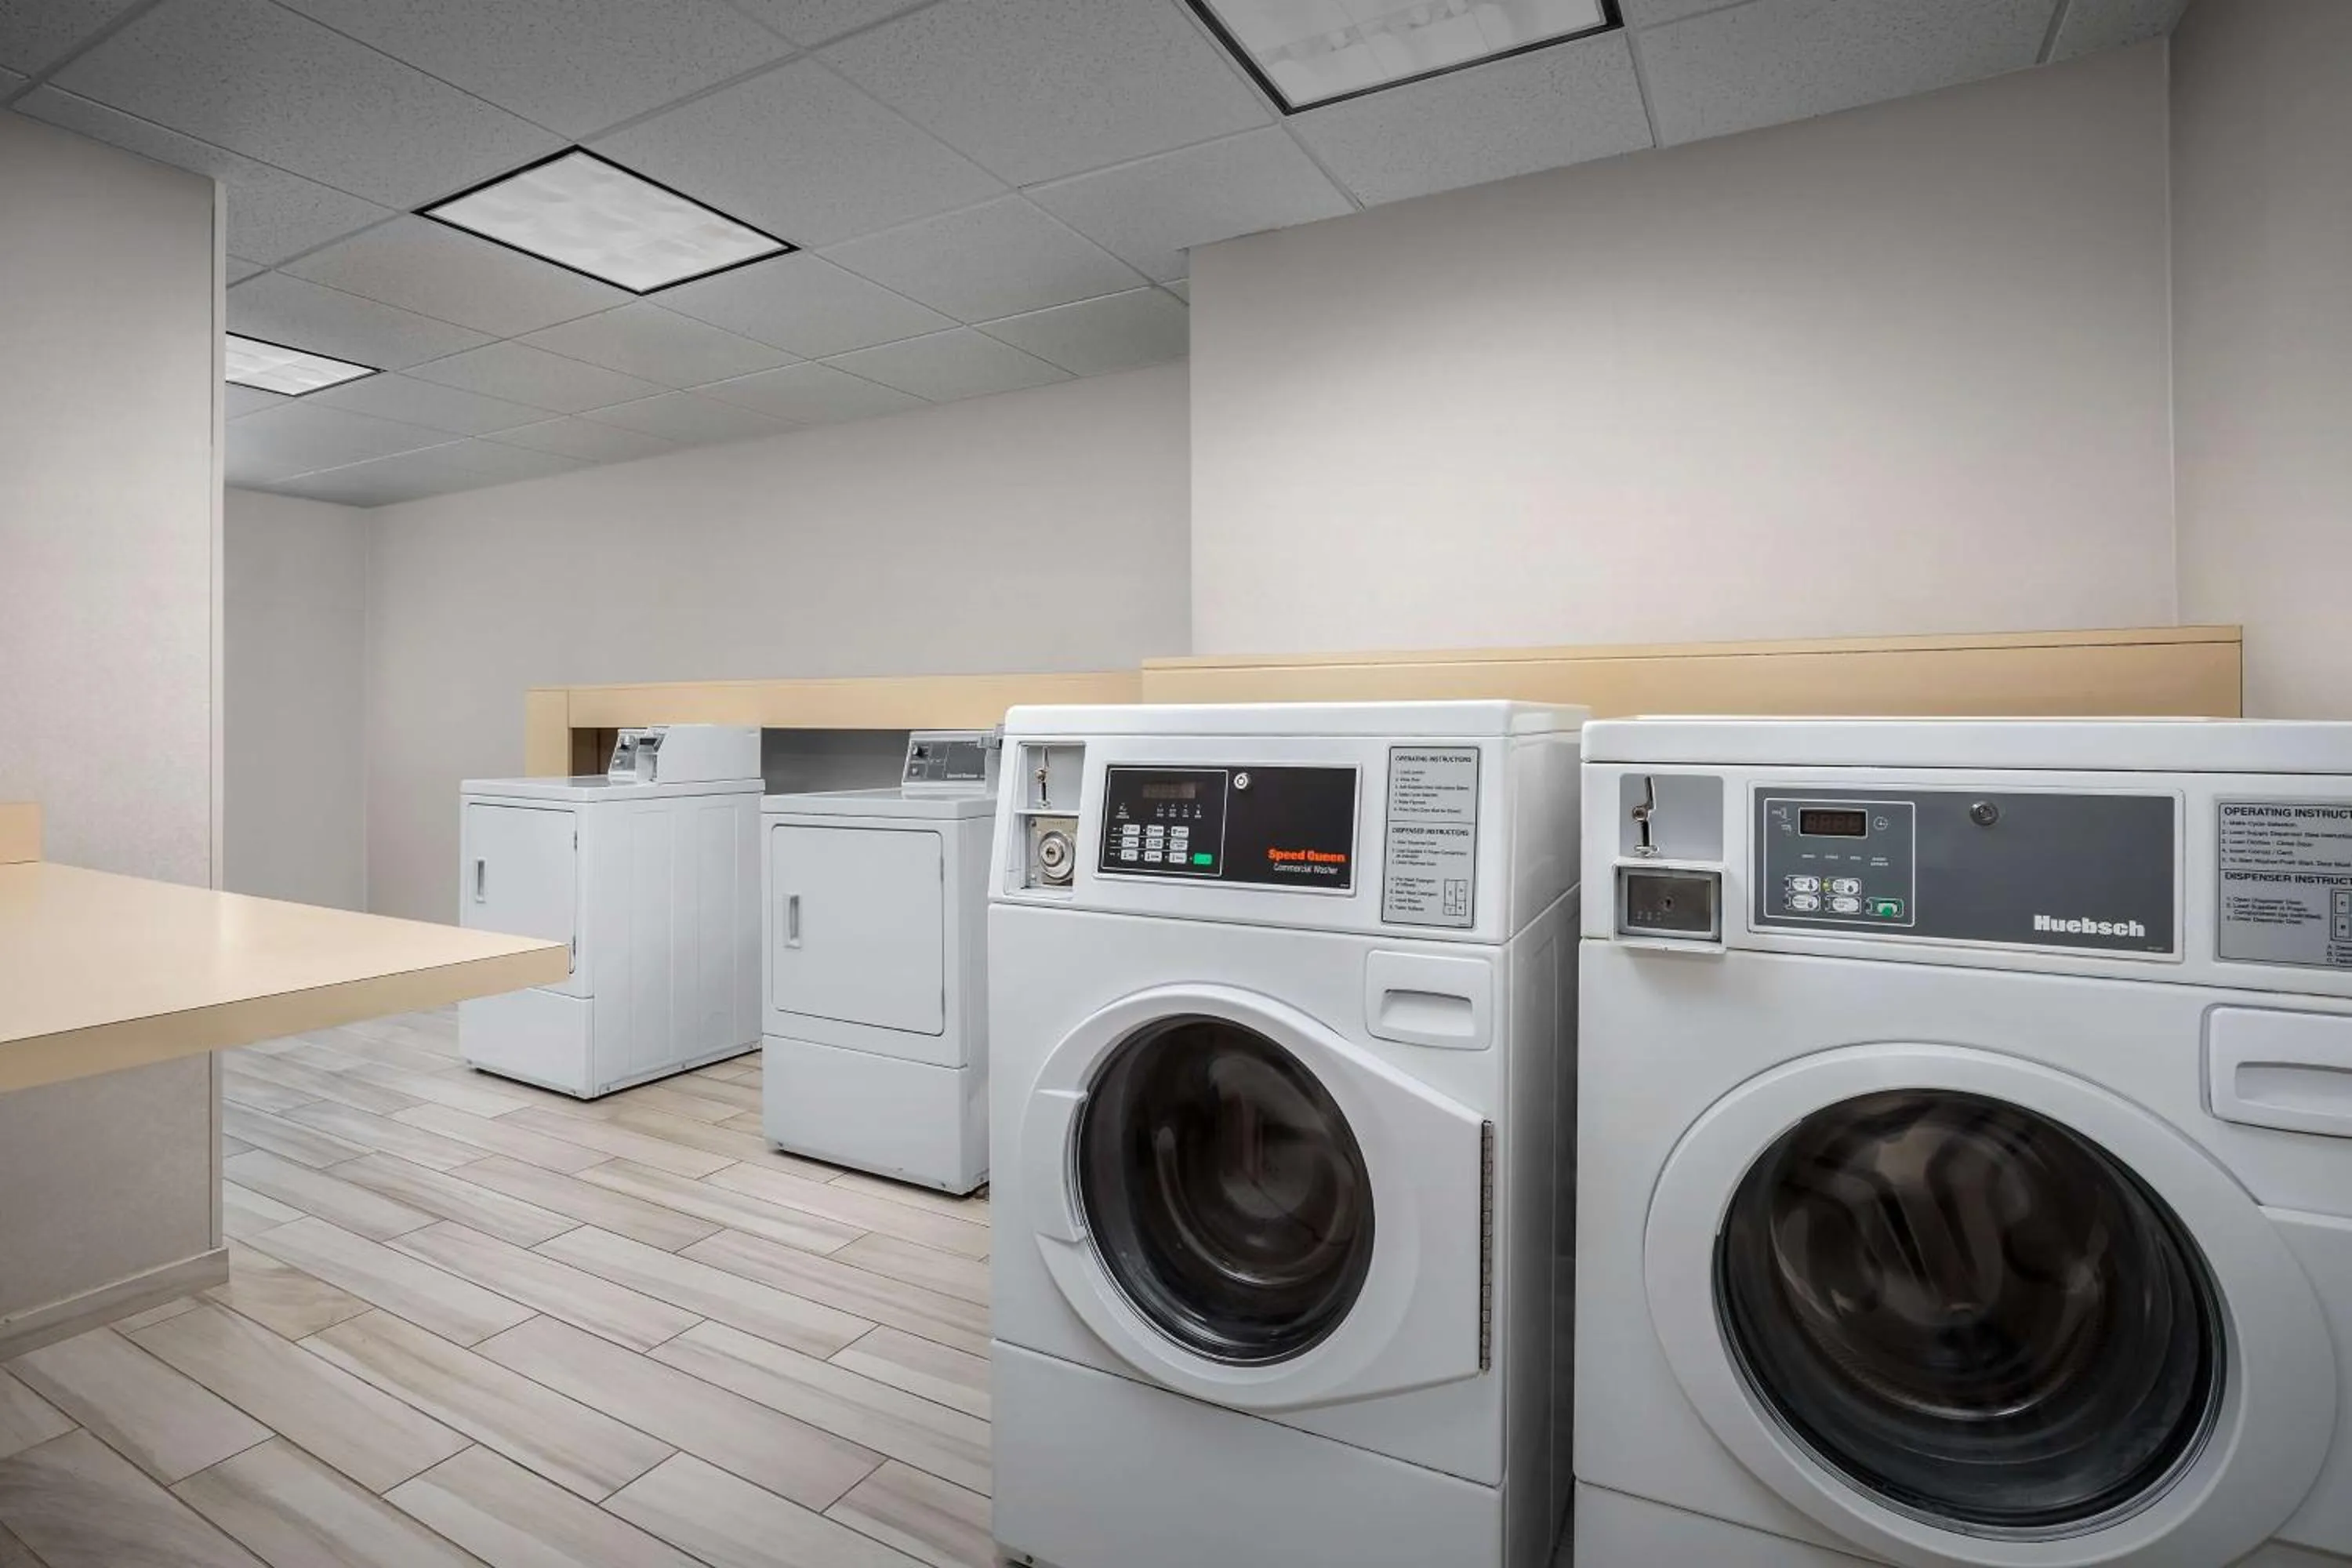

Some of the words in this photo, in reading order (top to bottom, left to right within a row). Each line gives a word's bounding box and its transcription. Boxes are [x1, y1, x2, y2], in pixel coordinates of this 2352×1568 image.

[2224, 807, 2291, 818] OPERATING
[1268, 848, 1305, 862] Speed
[1307, 850, 1346, 862] Queen
[1273, 863, 1312, 873] Commercial
[1314, 865, 1338, 874] Washer
[2224, 872, 2291, 882] DISPENSER
[2034, 915, 2146, 937] Huebsch
